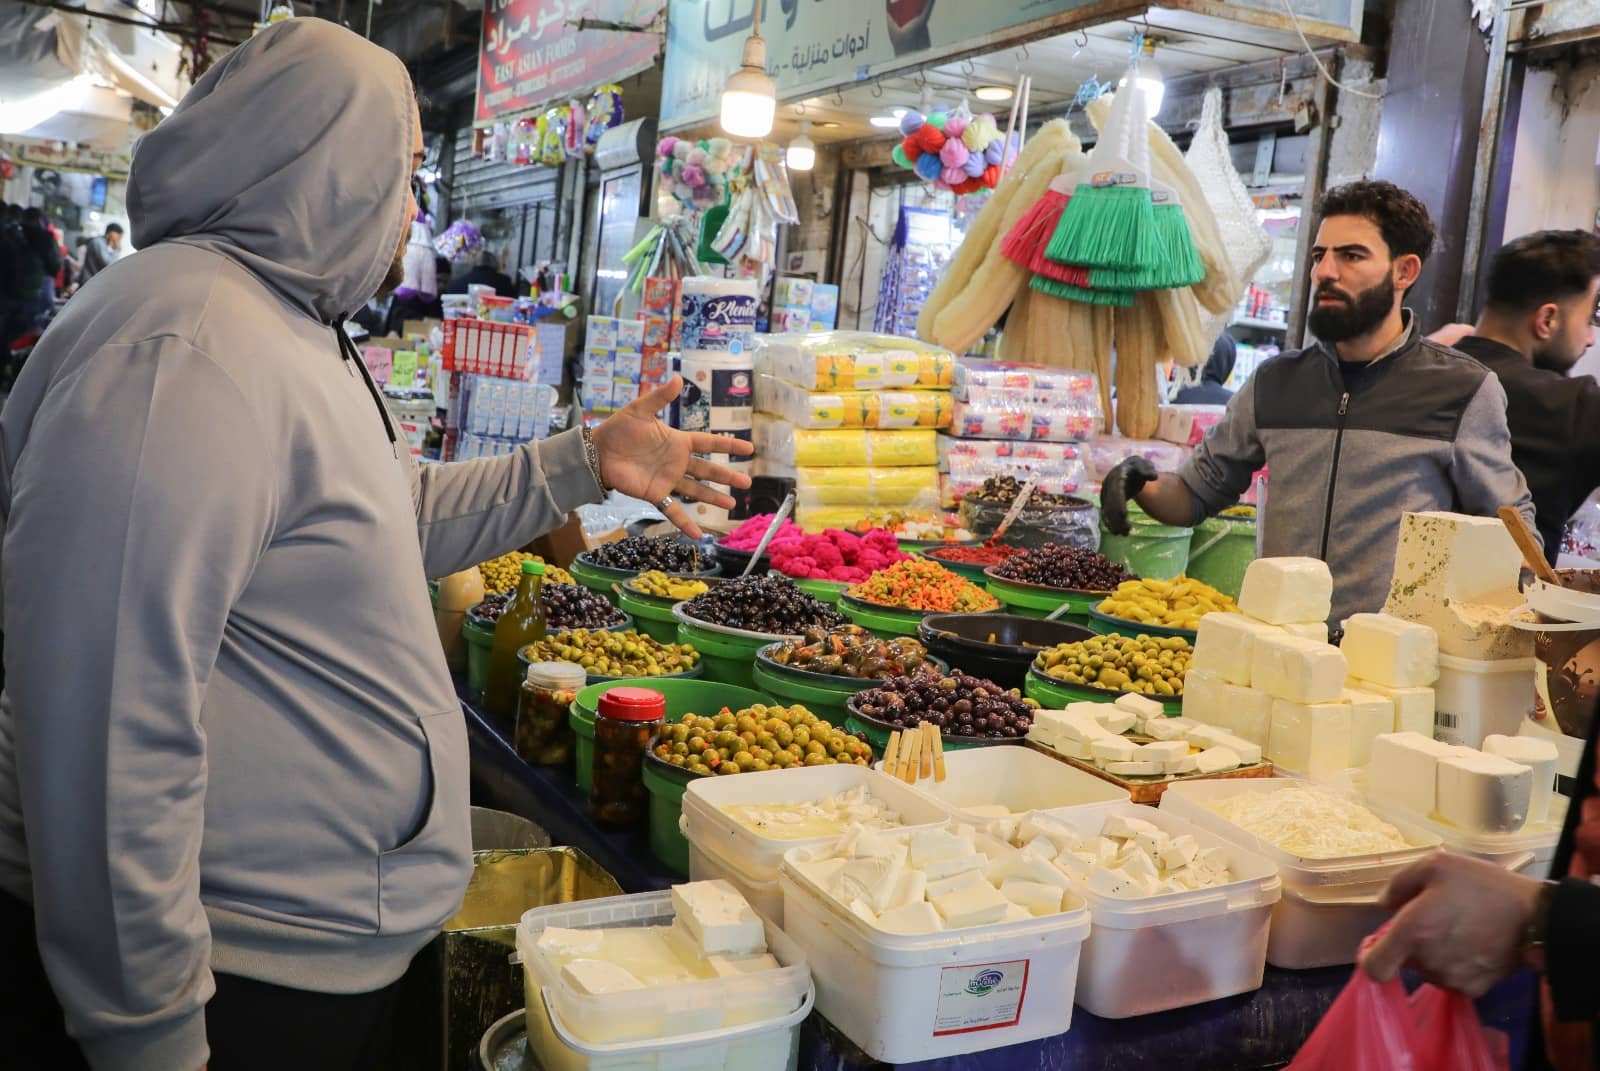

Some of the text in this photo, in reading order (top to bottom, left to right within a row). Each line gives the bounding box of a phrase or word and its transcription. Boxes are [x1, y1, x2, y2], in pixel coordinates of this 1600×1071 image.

[487, 15, 531, 54] مراد
[831, 17, 871, 59] أدوات
[495, 59, 514, 84] EAST
[518, 48, 544, 75] ASIAN
[545, 37, 577, 64] FOODS
[791, 42, 829, 74] منزلية
